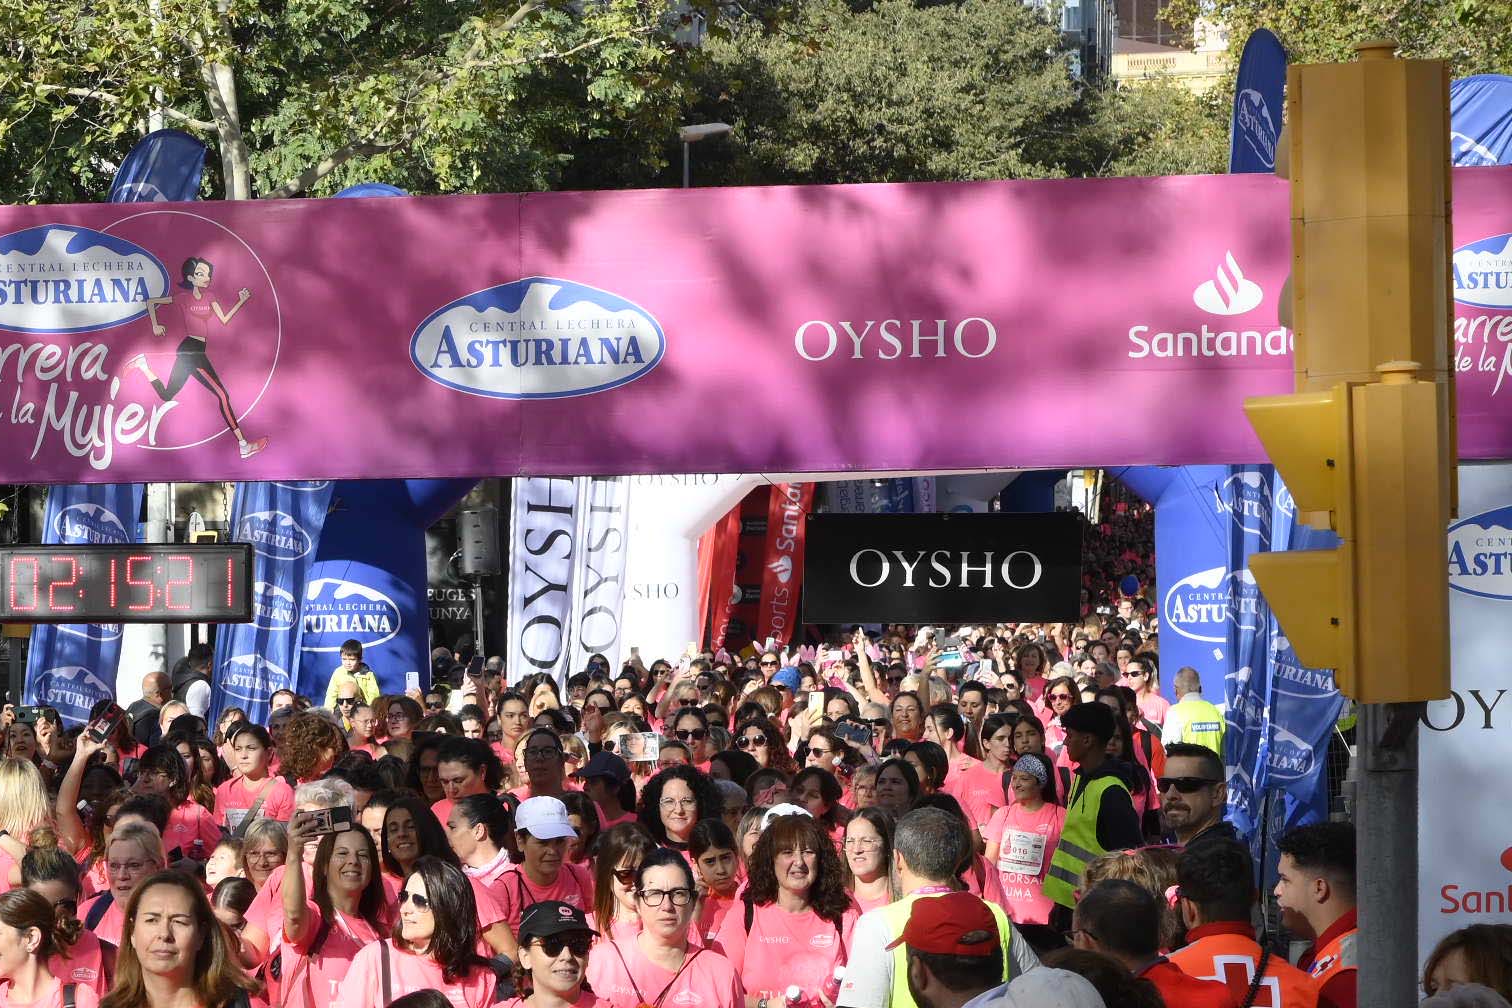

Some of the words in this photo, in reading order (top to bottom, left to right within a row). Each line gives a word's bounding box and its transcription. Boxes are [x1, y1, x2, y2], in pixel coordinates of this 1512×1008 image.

[72, 260, 145, 272] LECHERA
[469, 319, 548, 333] CENTRAL
[556, 318, 637, 330] LECHERA
[795, 318, 997, 361] OYSHO
[430, 325, 645, 370] ASTURIANA
[1478, 346, 1496, 372] la
[10, 385, 36, 426] la
[31, 377, 179, 470] Mujer
[849, 548, 1042, 590] OYSHO
[338, 603, 388, 612] LECHERA
[1172, 594, 1228, 623] ASTU
[1421, 690, 1508, 731] OY
